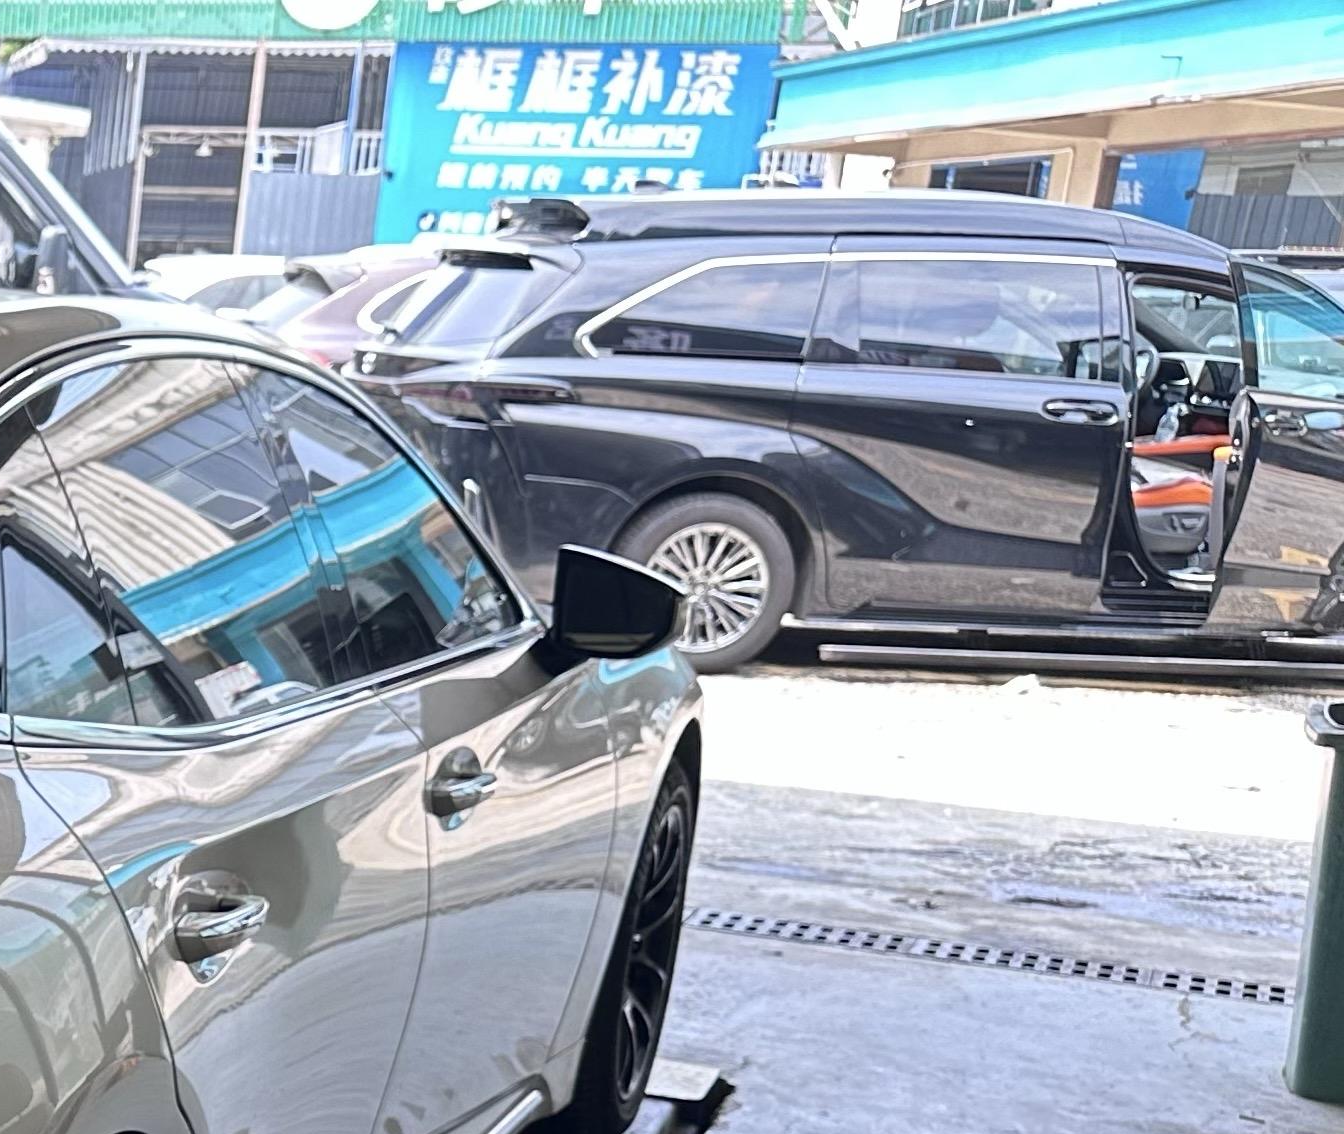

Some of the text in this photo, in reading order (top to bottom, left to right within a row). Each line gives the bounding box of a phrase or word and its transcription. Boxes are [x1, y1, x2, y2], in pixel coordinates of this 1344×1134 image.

[436, 47, 741, 116] 框框补漆
[453, 113, 701, 157] Kuang Kuang
